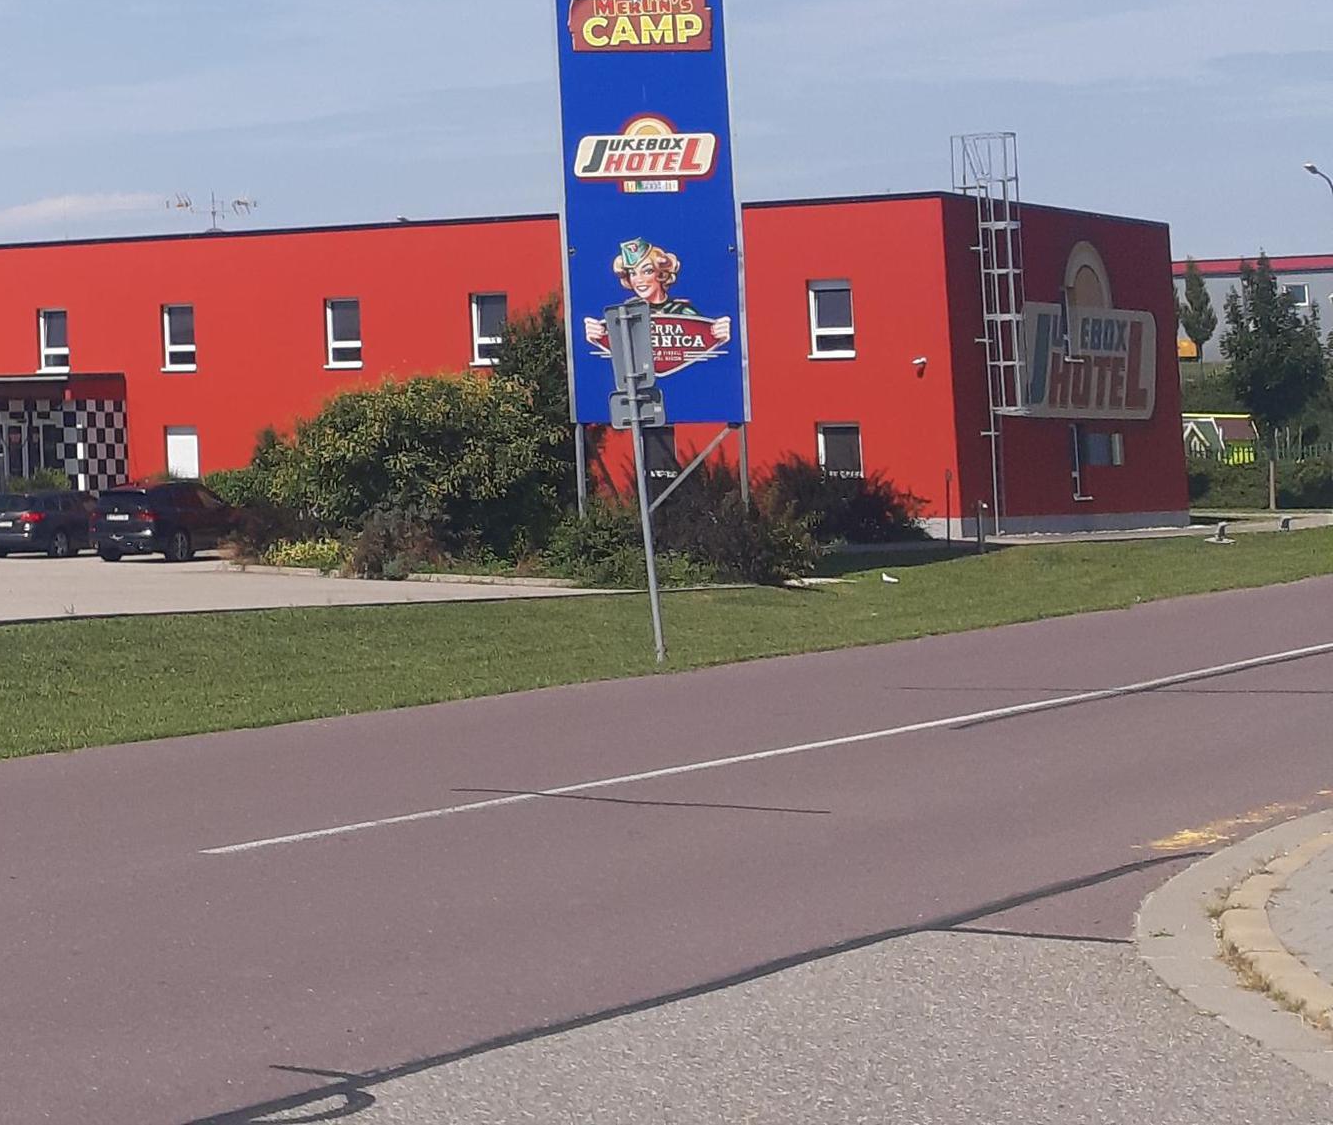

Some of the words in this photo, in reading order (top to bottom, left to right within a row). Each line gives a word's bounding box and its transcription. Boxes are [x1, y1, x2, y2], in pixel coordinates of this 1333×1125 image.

[582, 14, 703, 46] CAMP
[581, 137, 684, 173] JUKEBOX
[603, 138, 702, 173] HOTEL
[1026, 314, 1128, 405] JUEBOX
[1048, 320, 1148, 410] HOTEL
